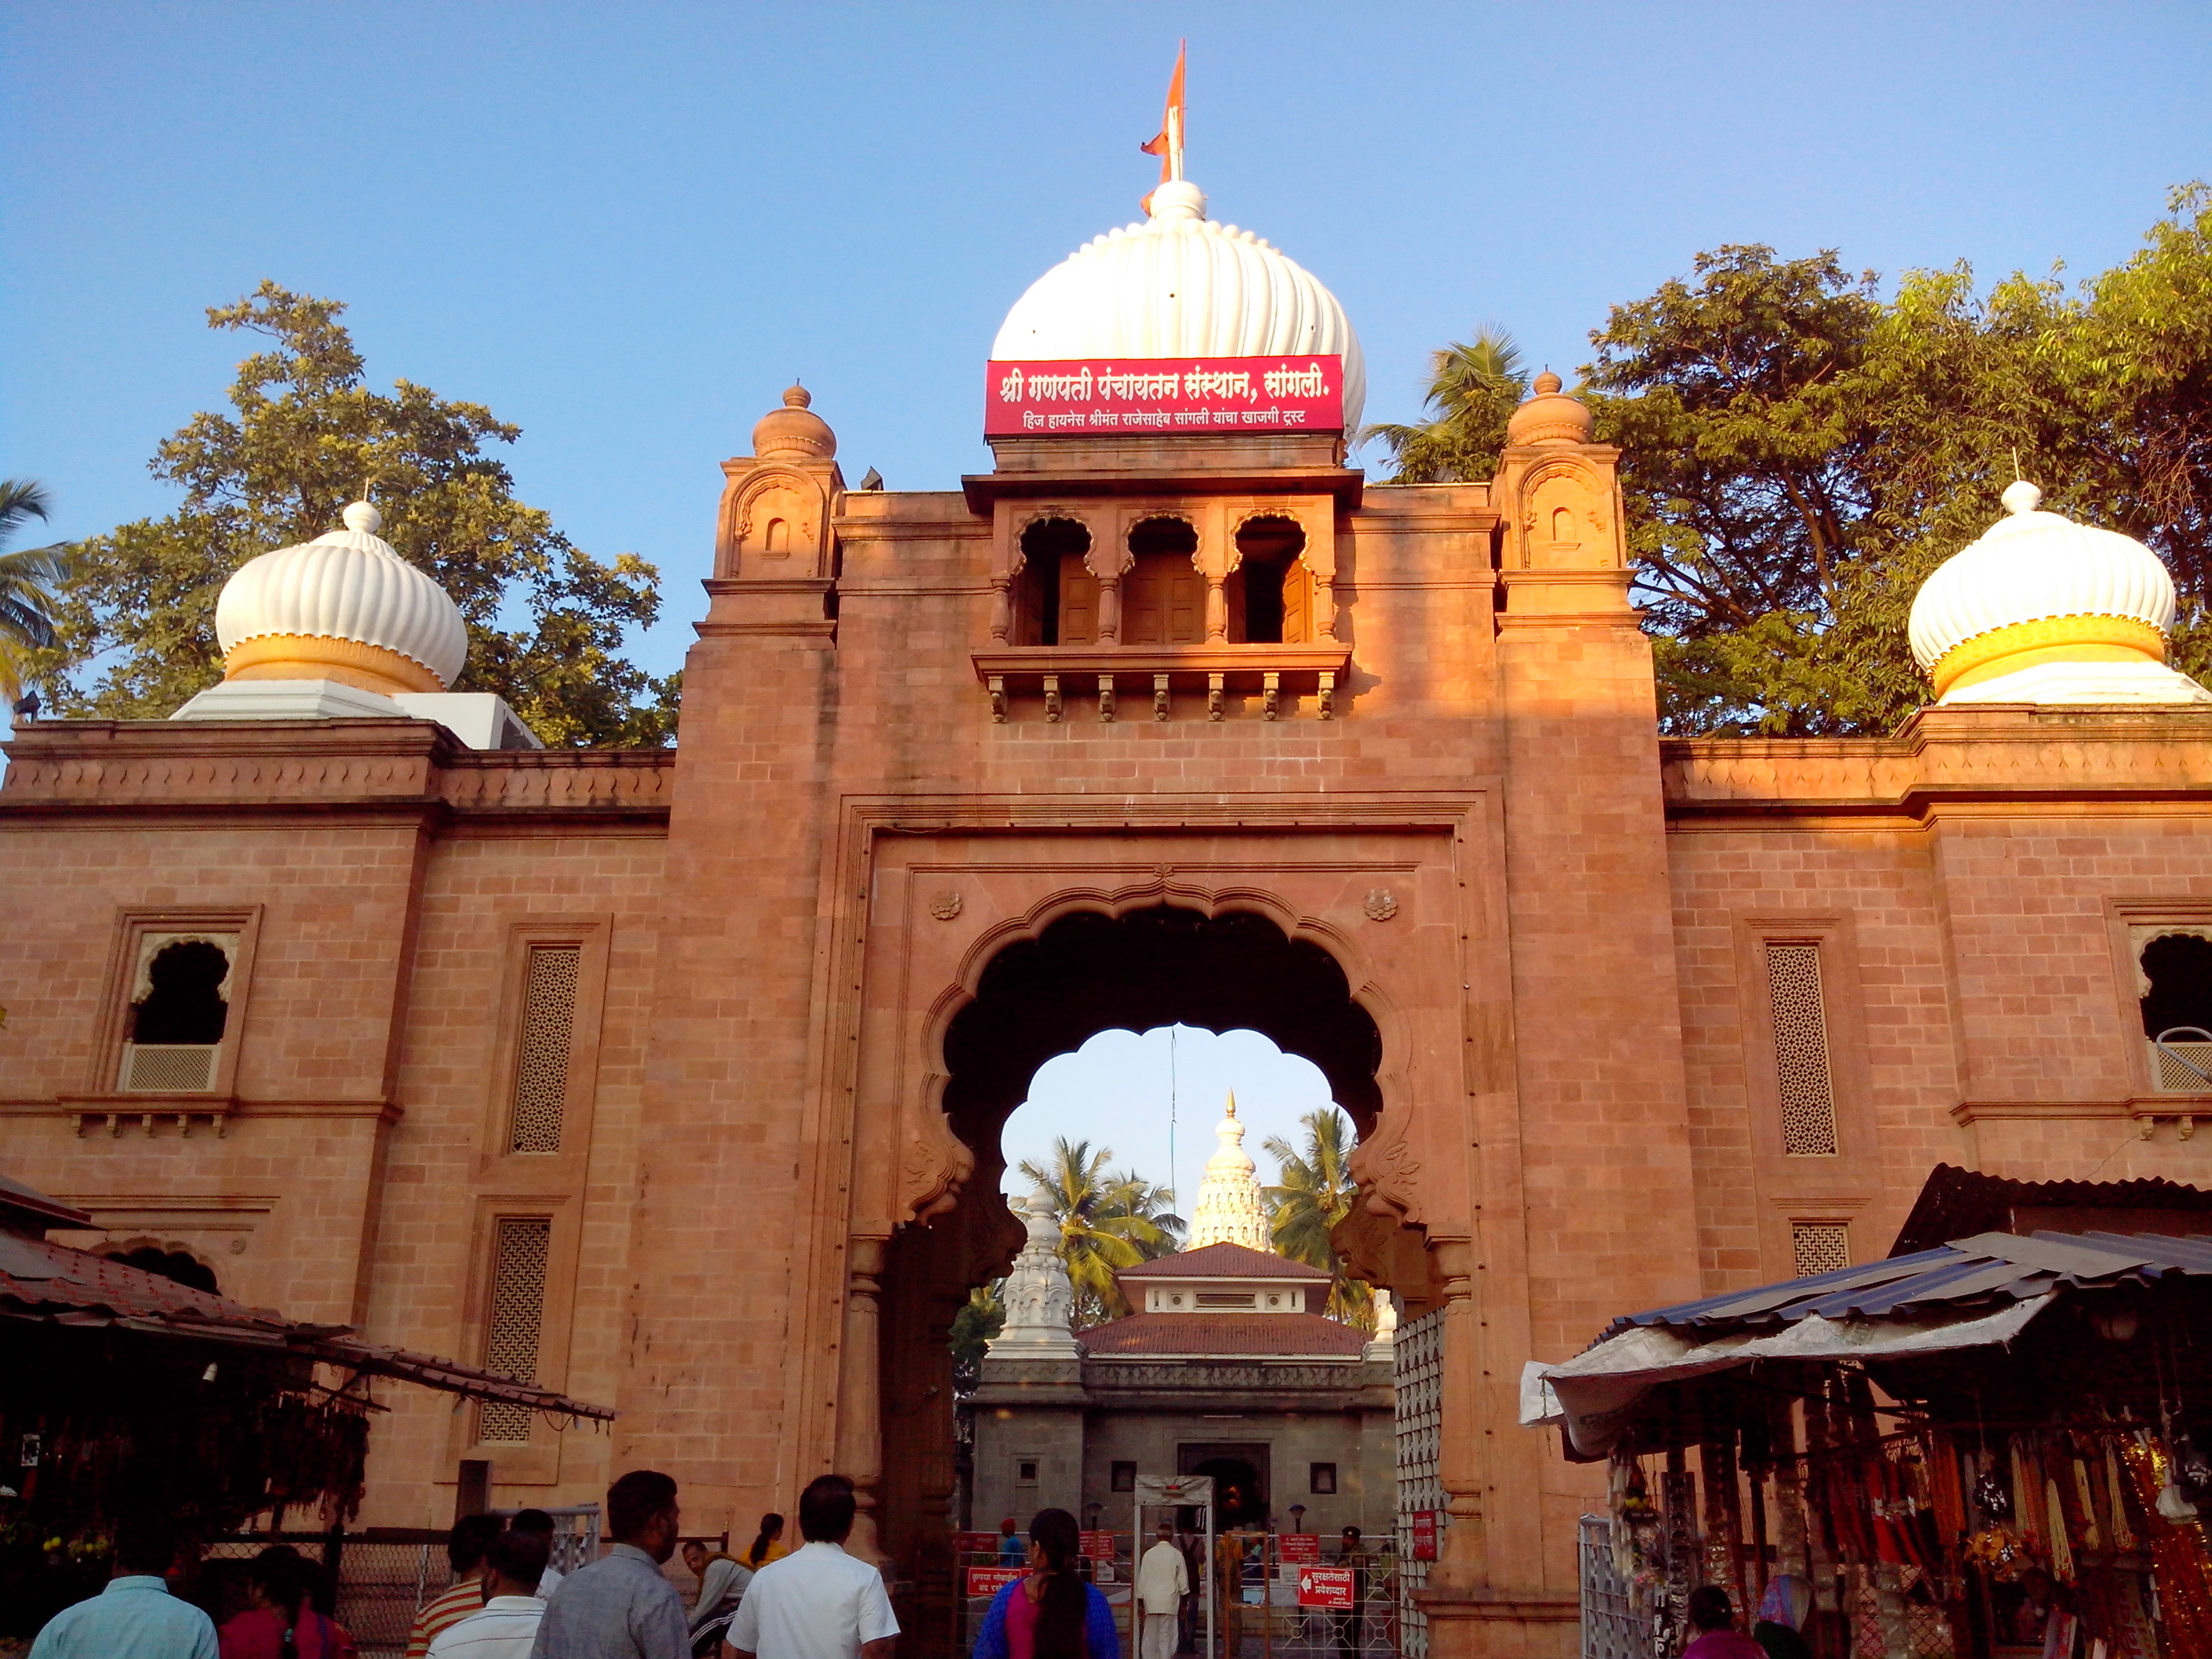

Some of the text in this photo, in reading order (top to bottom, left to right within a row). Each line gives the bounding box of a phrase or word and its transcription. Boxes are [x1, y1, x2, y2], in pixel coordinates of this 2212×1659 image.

[1000, 362, 1330, 405] श्री गणपती पंचायतन संस्थान, सांगली.
[1023, 406, 1305, 429] हिज हायनेस श्रीमंत राजेसाहेब सांगली यांचा खाजगी ट्रस्ट
